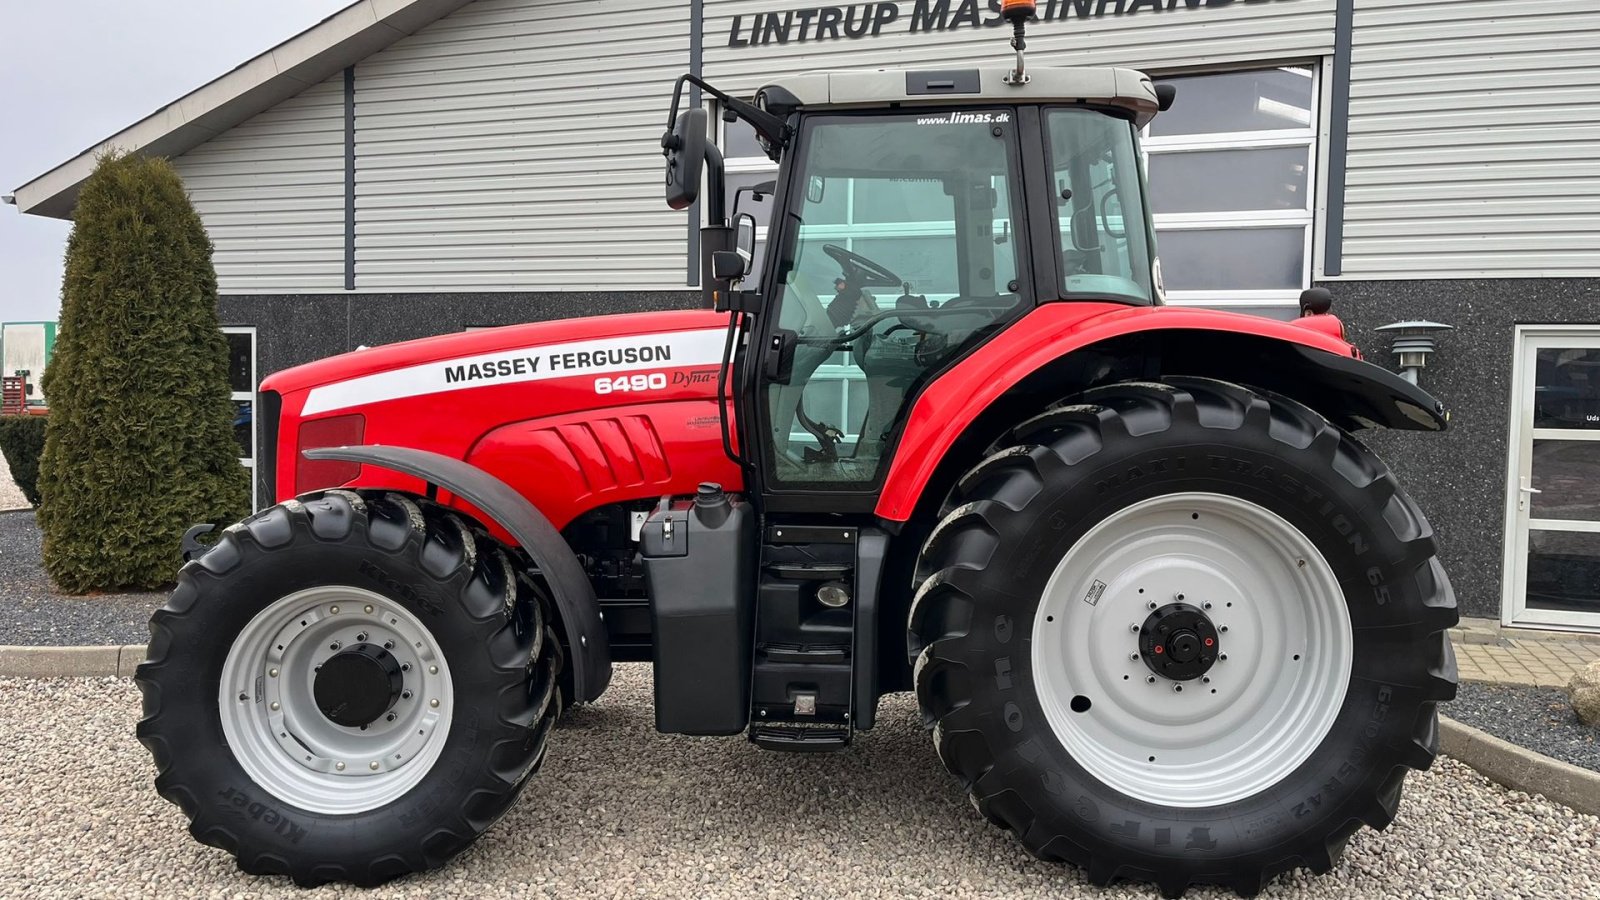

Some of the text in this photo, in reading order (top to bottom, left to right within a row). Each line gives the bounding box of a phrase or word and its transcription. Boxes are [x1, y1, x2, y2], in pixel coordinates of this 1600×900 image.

[728, 1, 899, 48] LINTRUP
[916, 111, 1010, 125] www.limas.dk
[444, 344, 672, 383] MASSEY FERGUSON
[594, 371, 721, 395] 6490 Dyna-
[1094, 454, 1391, 605] MAXI TRACTION 65
[358, 557, 447, 616] Kleber
[218, 786, 308, 844] Kleber
